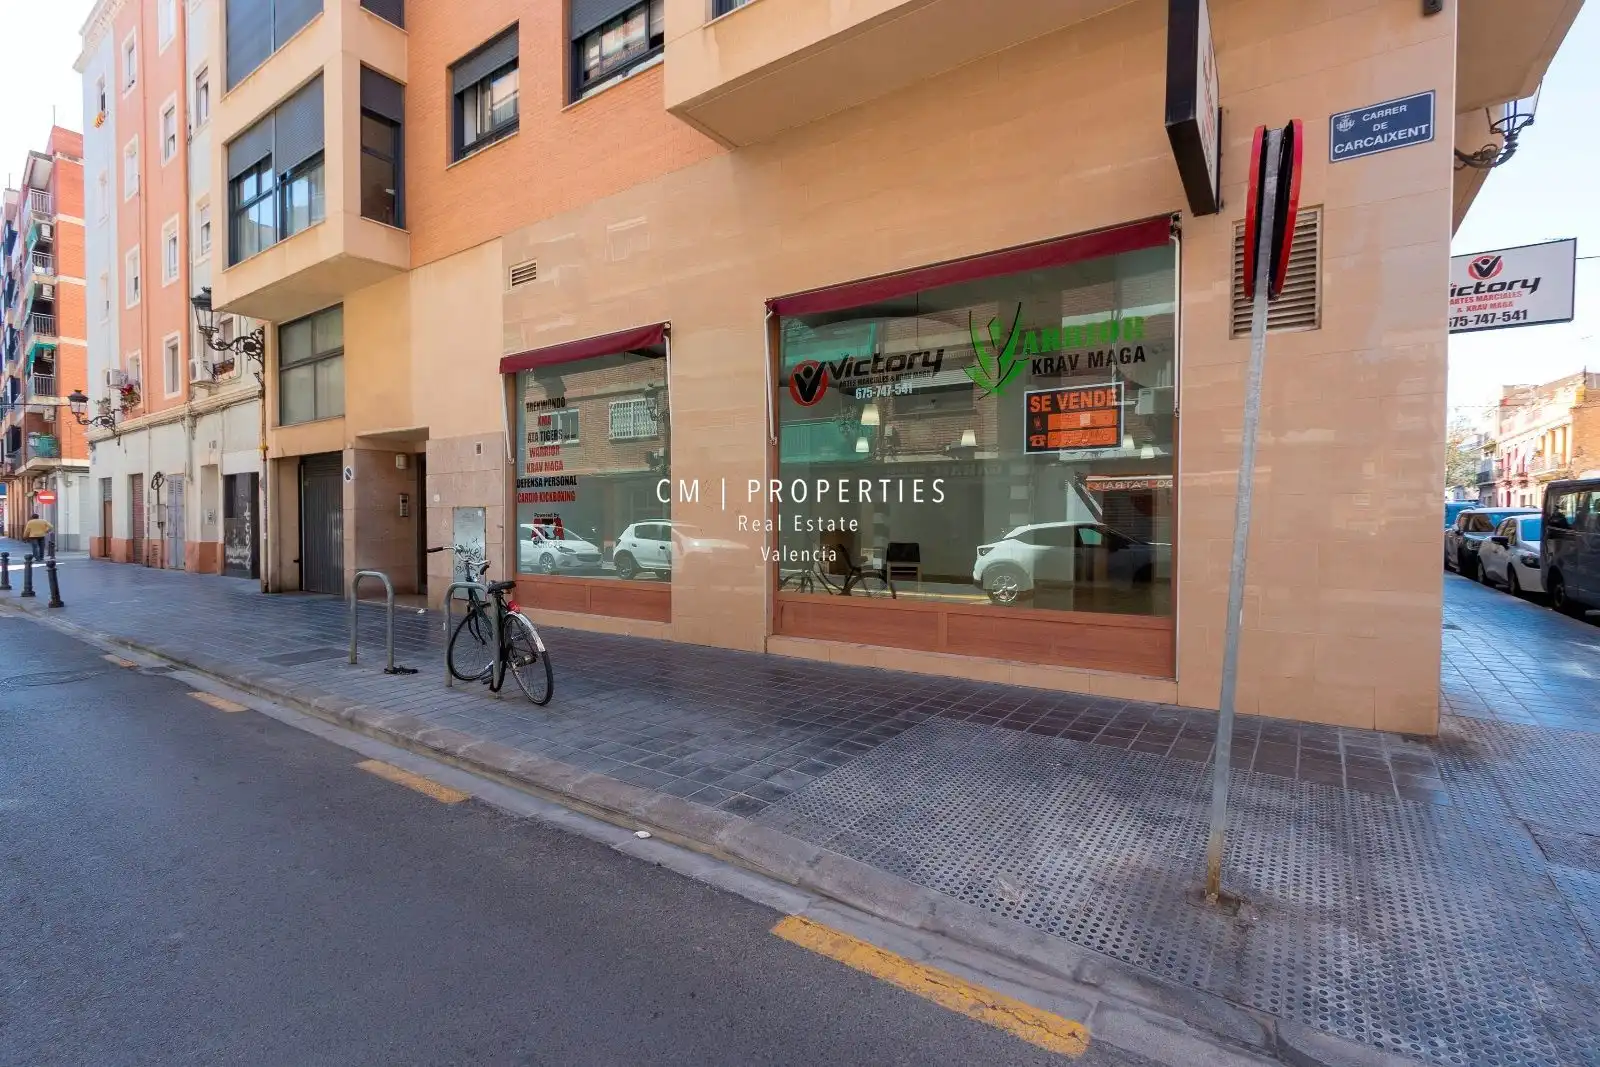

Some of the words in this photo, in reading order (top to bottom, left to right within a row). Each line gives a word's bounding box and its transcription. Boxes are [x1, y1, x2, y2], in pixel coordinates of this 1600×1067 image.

[1362, 104, 1408, 121] CARRER
[1373, 121, 1388, 132] DE
[1334, 123, 1429, 154] CARCAIXENT
[1449, 277, 1541, 298] ictory
[1476, 290, 1523, 302] MARCIALES
[1466, 303, 1488, 312] KRAV
[1490, 301, 1514, 310] MAGA
[828, 348, 945, 380] Victory
[1031, 354, 1080, 376] KRAV
[1088, 345, 1146, 369] MAGA
[855, 382, 913, 400] 675-747-541
[526, 396, 566, 413] TAEKWONDO
[1030, 394, 1052, 413] SE
[1056, 387, 1117, 411] VENDE
[527, 431, 539, 443] ATA
[540, 429, 563, 442] TIGERS
[529, 445, 561, 458] WARRIOR
[526, 462, 543, 473] KRAV
[544, 460, 564, 472] MAGA
[516, 477, 543, 489] DEFENSA
[543, 475, 577, 487] PERSONAL
[517, 492, 539, 503] CARDIO
[540, 490, 576, 503] KICKBOXING
